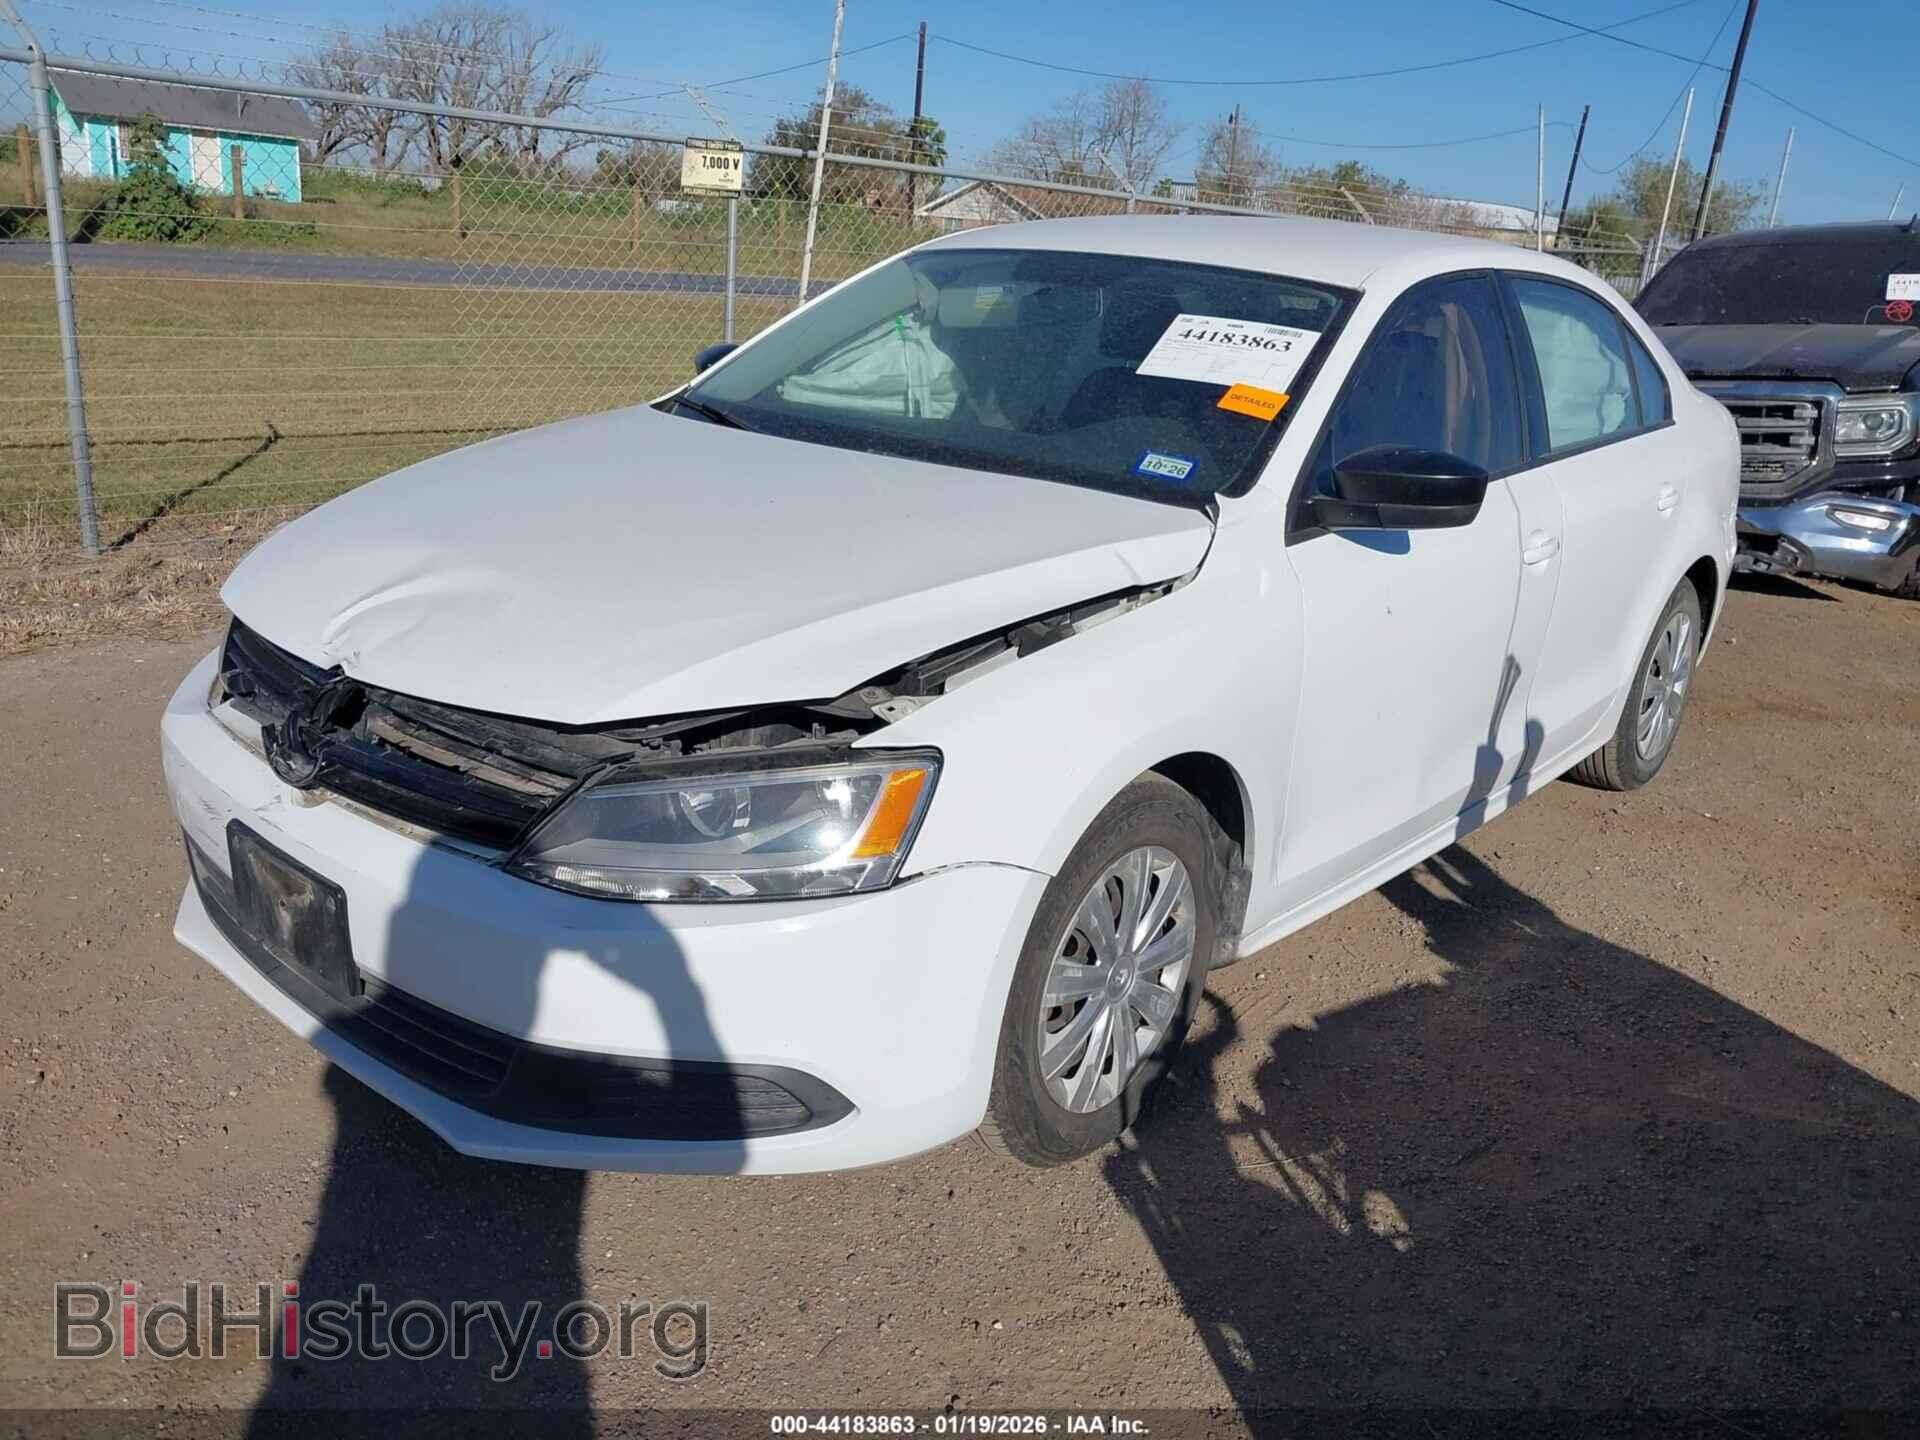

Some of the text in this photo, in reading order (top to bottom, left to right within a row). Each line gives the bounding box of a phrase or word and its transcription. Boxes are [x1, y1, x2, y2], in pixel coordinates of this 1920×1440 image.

[702, 155, 740, 170] 7,000 V
[1178, 328, 1292, 353] 44183863
[1230, 393, 1276, 410] DETAILED
